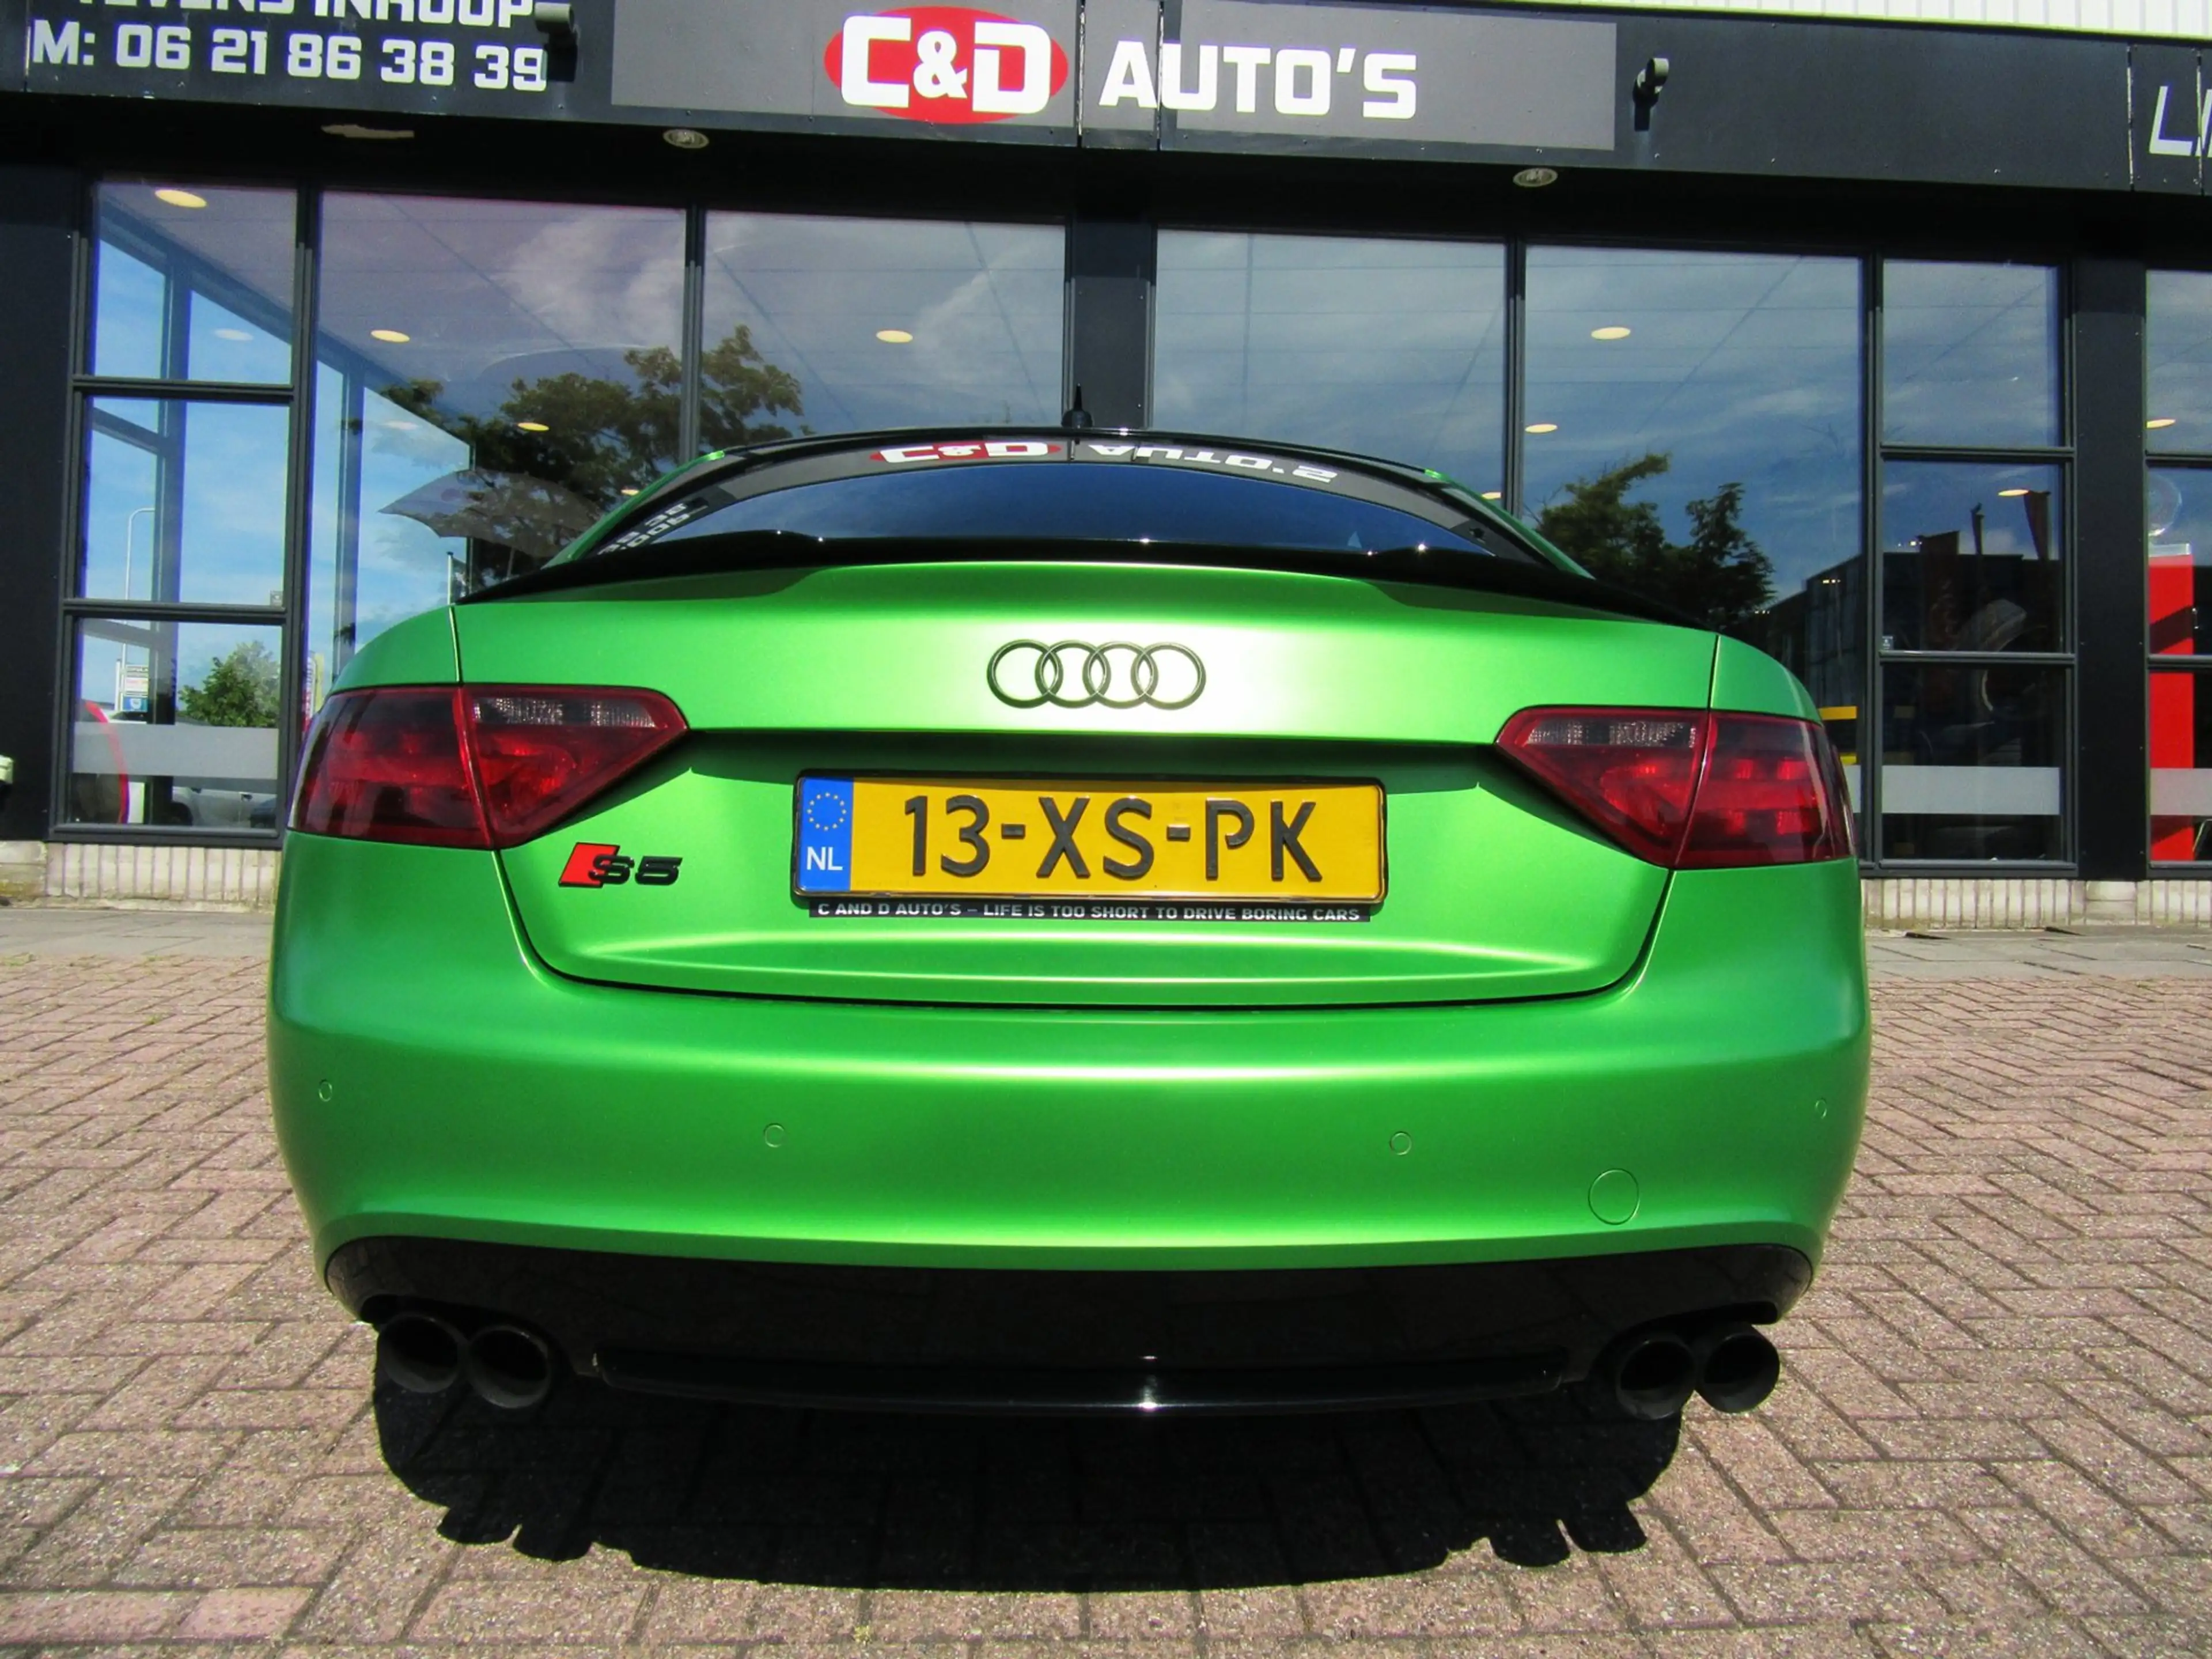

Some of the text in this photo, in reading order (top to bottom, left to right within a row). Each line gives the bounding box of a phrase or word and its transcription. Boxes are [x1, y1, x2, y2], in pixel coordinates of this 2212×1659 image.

[33, 19, 547, 92] M: 06 21 86 38 39
[841, 15, 1417, 119] C&D AUTO'S
[807, 846, 843, 871] NL
[904, 794, 1323, 883] 13-XS-PK
[588, 854, 683, 886] S5
[817, 903, 831, 916] C
[834, 903, 873, 916] AND
[877, 903, 891, 916] D
[895, 903, 962, 916] AUTO'S
[983, 904, 1023, 917] LIFE
[1028, 905, 1046, 918] IS
[1052, 906, 1086, 918] TOO
[1090, 906, 1150, 919] SHORT
[1156, 907, 1178, 920] TO
[1183, 907, 1236, 921] DRIVE
[1241, 908, 1308, 921] BORING
[1312, 908, 1361, 922] CARS
